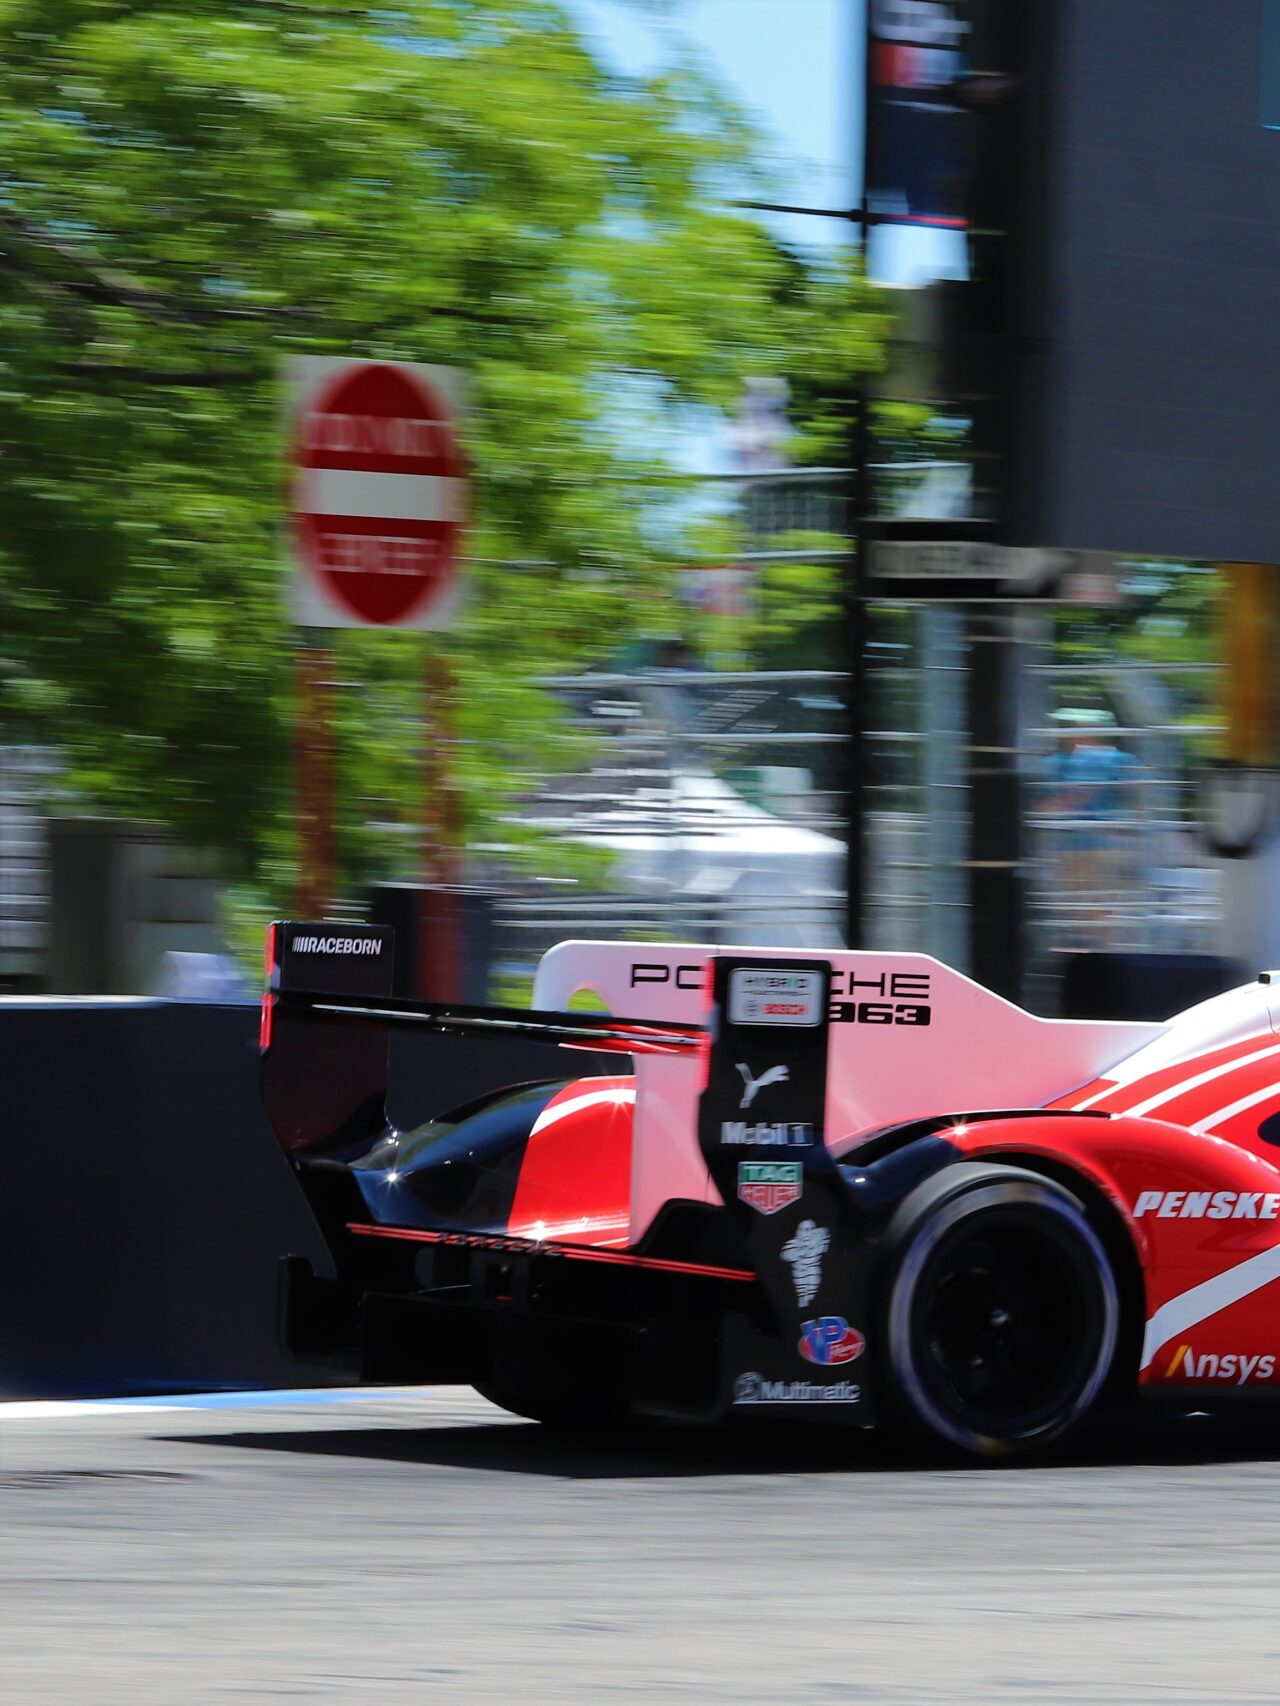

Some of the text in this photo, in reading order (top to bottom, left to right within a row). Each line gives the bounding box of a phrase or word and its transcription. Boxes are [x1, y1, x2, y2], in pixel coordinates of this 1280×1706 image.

[305, 937, 382, 955] RACEBORN
[721, 1122, 788, 1145] Mobil
[1164, 1345, 1276, 1385] Ansys
[761, 1381, 860, 1400] Multimatic
